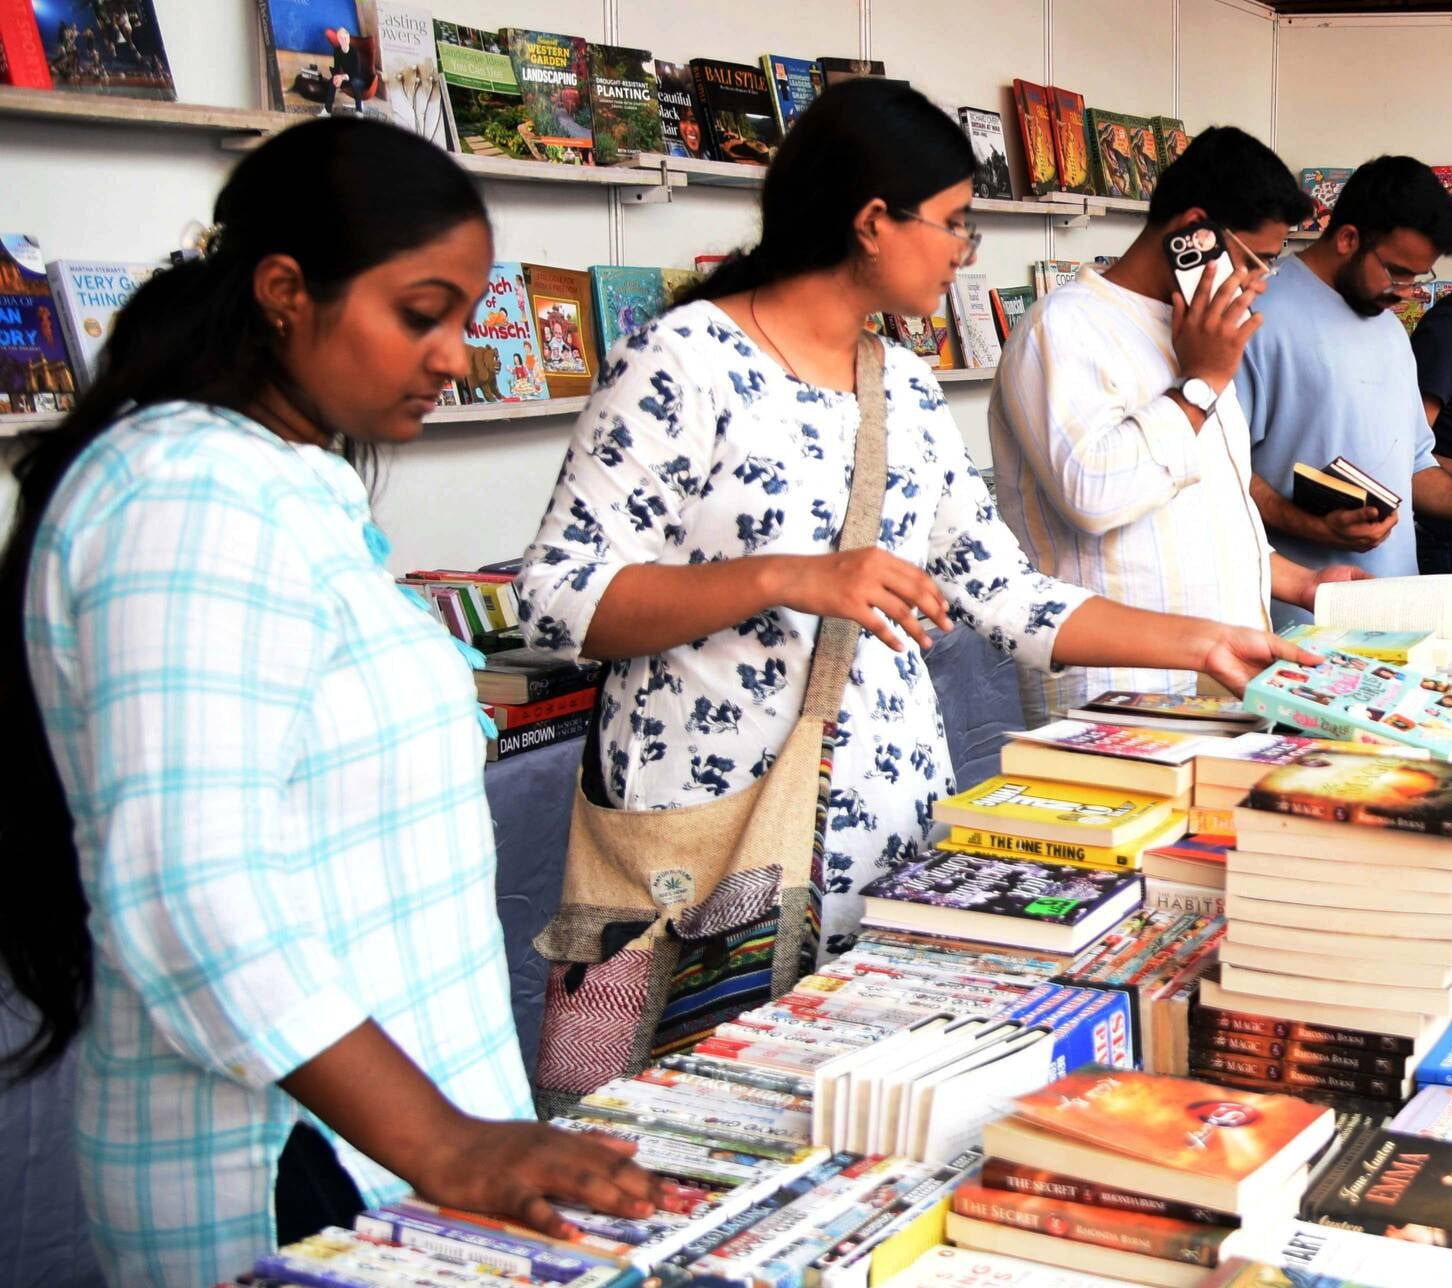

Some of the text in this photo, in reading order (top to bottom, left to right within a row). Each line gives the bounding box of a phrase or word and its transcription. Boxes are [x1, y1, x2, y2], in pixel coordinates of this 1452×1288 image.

[527, 44, 570, 58] WESTERN
[530, 52, 567, 67] GARDEN
[522, 67, 577, 86] LANDSCAPING
[704, 64, 769, 91] BALI STYLE
[597, 85, 651, 101] PLANTING
[657, 91, 692, 107] eautiful
[72, 275, 113, 290] VERY
[485, 298, 497, 308] of
[466, 322, 531, 341] Munsch!
[501, 726, 556, 753] DAN BROWN
[1291, 804, 1327, 817] MAGIC
[1397, 817, 1427, 831] BYRNE
[990, 835, 1086, 862] THE ONE THING
[1233, 1019, 1364, 1047] MAGIC RHONDA BYRNE
[1228, 1038, 1360, 1068] MAGIC RHONDA BYRNE
[1225, 1060, 1356, 1091] MAGIC RHONDA BYRNE
[1338, 1140, 1397, 1207] Jane Austen
[1364, 1153, 1431, 1207] EMMA
[1008, 1175, 1167, 1211] THE SECRET RHONDA BYRNE
[962, 1198, 1151, 1251] THE SECRET RHONDA BYRNE
